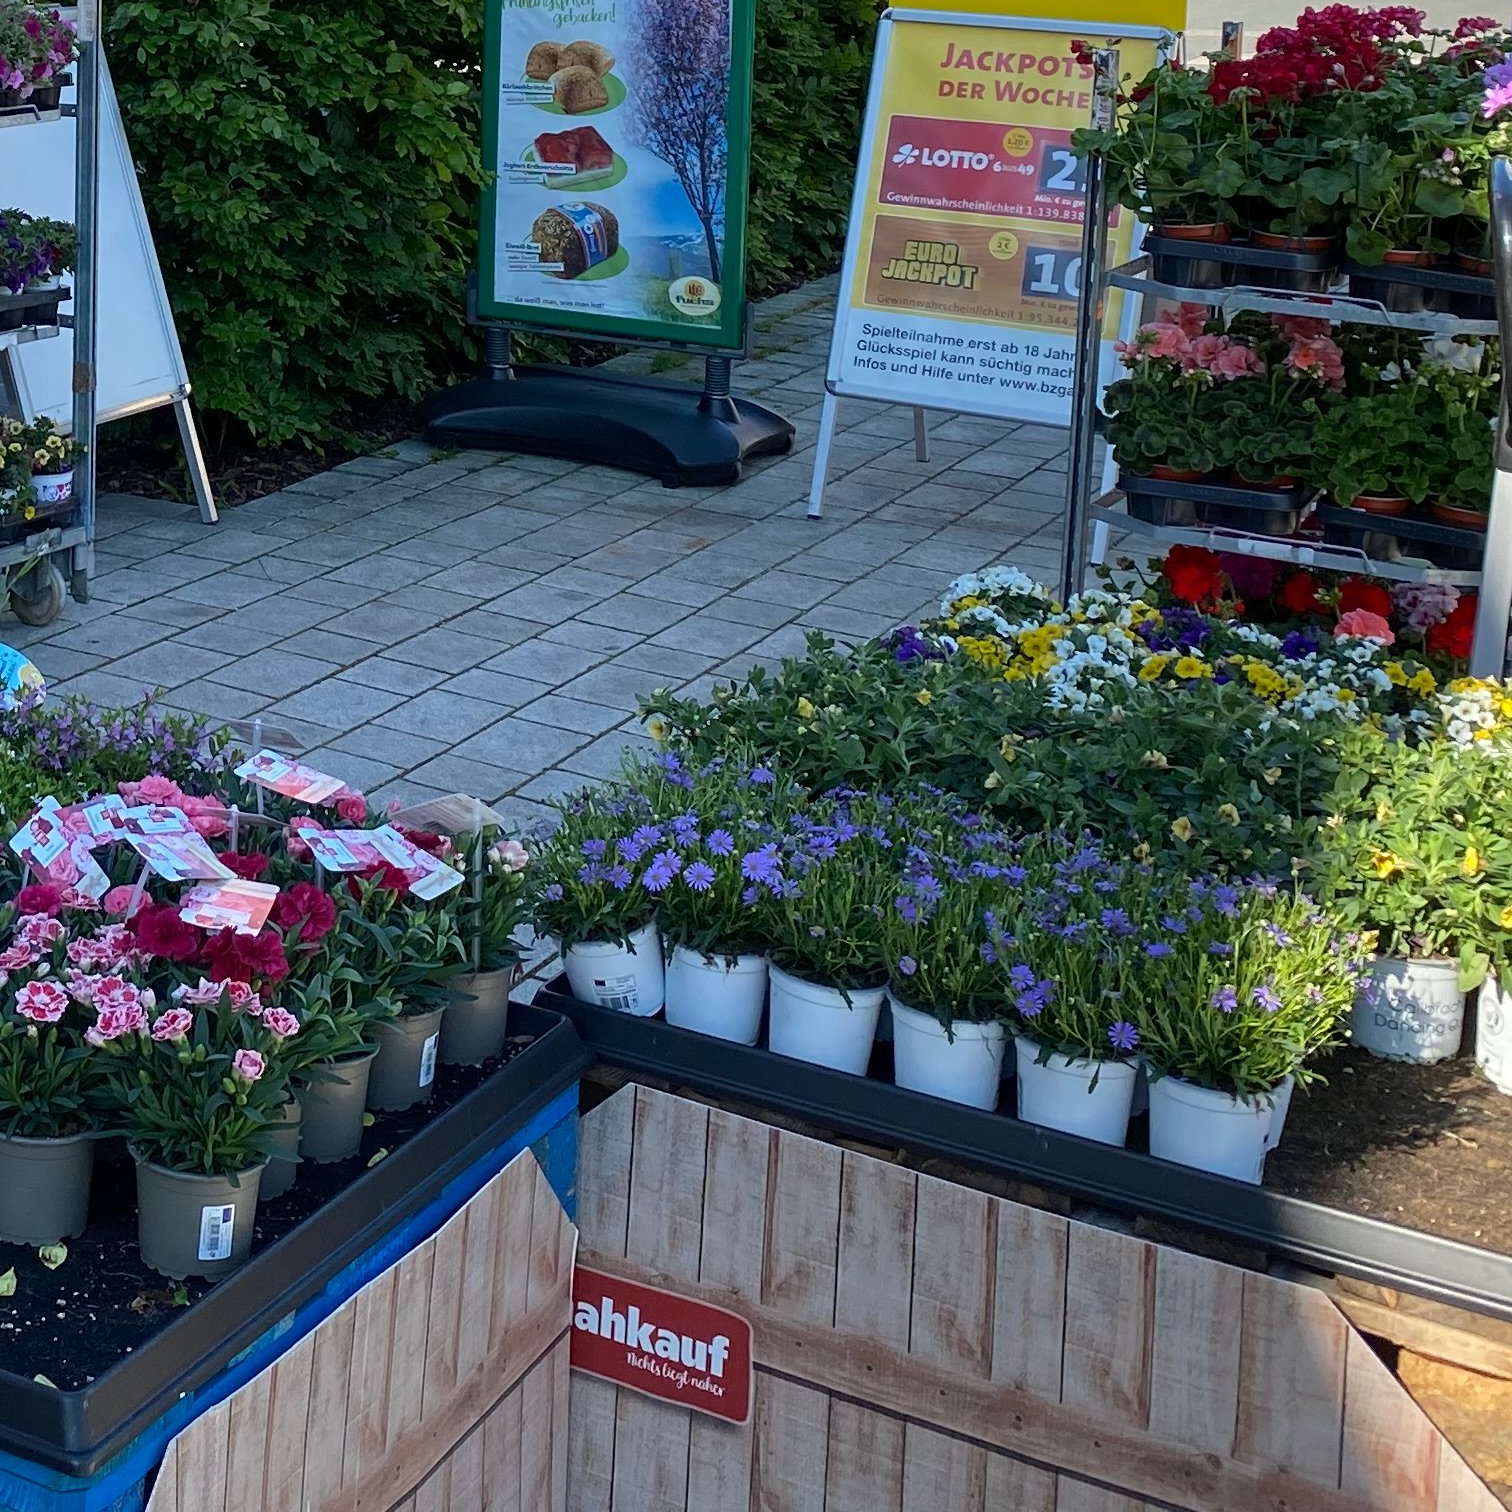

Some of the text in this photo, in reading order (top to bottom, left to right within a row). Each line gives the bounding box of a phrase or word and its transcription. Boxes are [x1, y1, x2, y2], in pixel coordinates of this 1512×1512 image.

[552, 2, 616, 28] gebacken!
[938, 80, 1090, 109] DER WOCHE
[921, 148, 989, 170] LOTTO
[887, 192, 1024, 215] Gewinnwahrscheinlichkeit
[904, 240, 959, 264] EURO
[881, 259, 979, 289] JACKPOT
[877, 294, 1014, 319] Gewinnwahrscheinlichkeit
[862, 323, 964, 348] Spielteilnahme
[966, 338, 996, 352] erst
[1001, 342, 1019, 354] ab
[1024, 344, 1039, 356] 18
[853, 355, 887, 371] Infos
[890, 362, 917, 375] und
[921, 364, 954, 380] Hilfe
[957, 372, 994, 386] unter
[856, 339, 937, 362] Glücksspiel
[940, 352, 975, 366] kann
[979, 355, 1032, 376] süchtig
[1374, 1013, 1445, 1036] Dancing
[626, 1352, 661, 1377] Nichts
[662, 1364, 690, 1390] liegt
